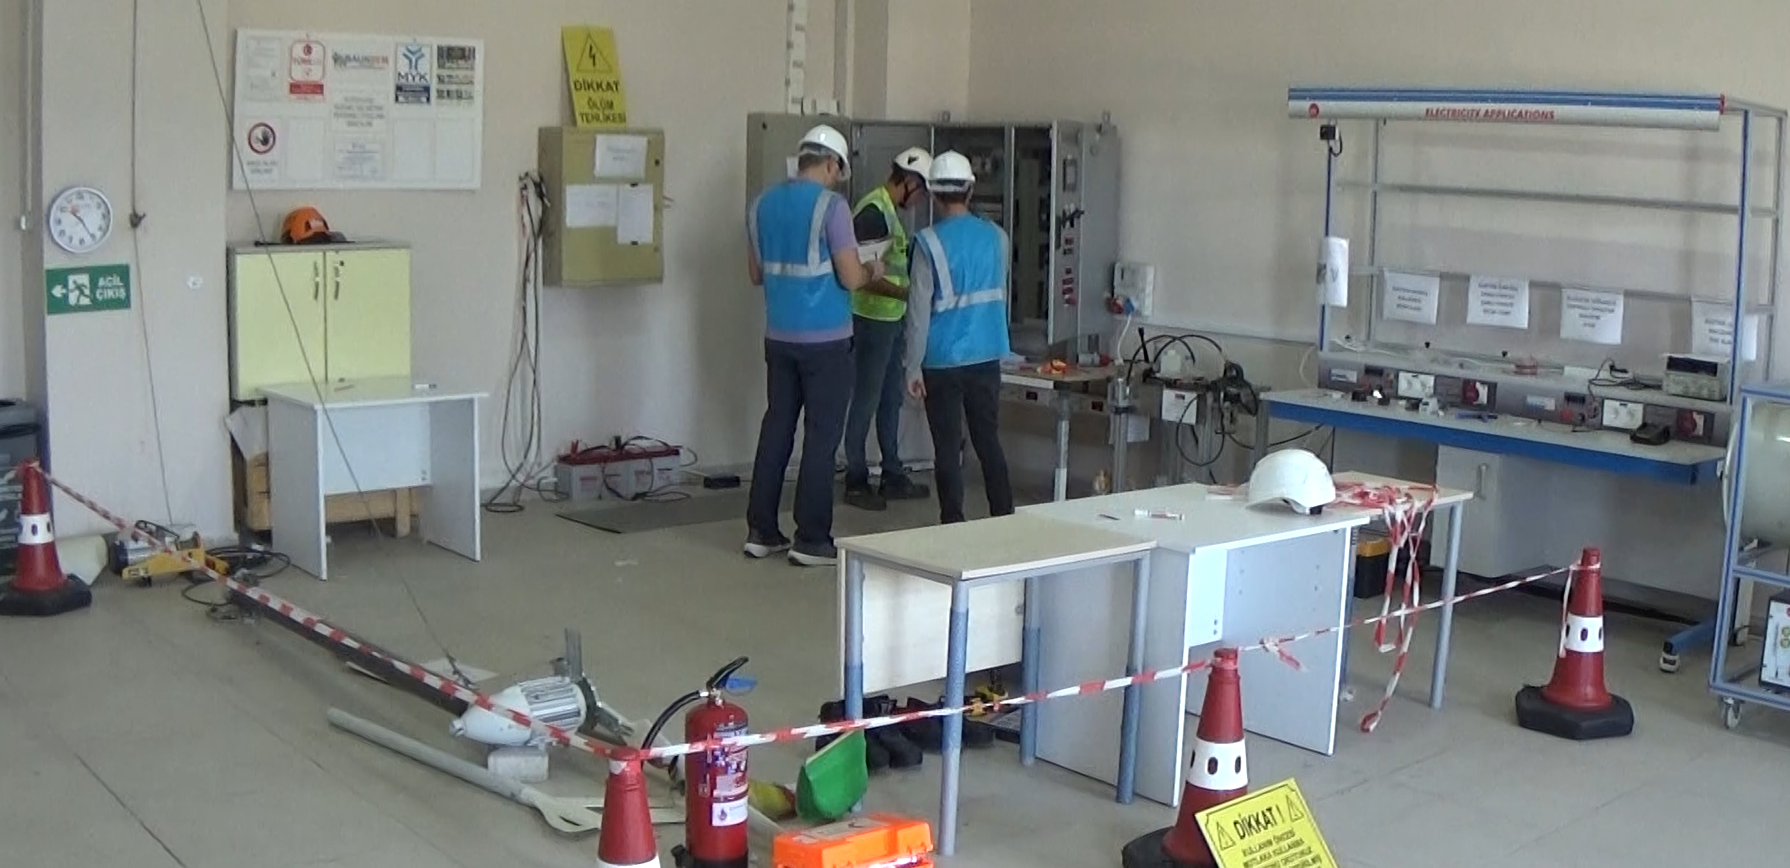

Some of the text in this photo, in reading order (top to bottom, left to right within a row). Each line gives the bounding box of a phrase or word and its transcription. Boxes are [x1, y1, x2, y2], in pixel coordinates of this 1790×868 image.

[398, 72, 428, 83] MYK
[573, 79, 620, 94] DİKKAT
[1425, 108, 1555, 120] ELECTRICITY APPLICATIONS
[1233, 806, 1278, 840] DİKKAT
